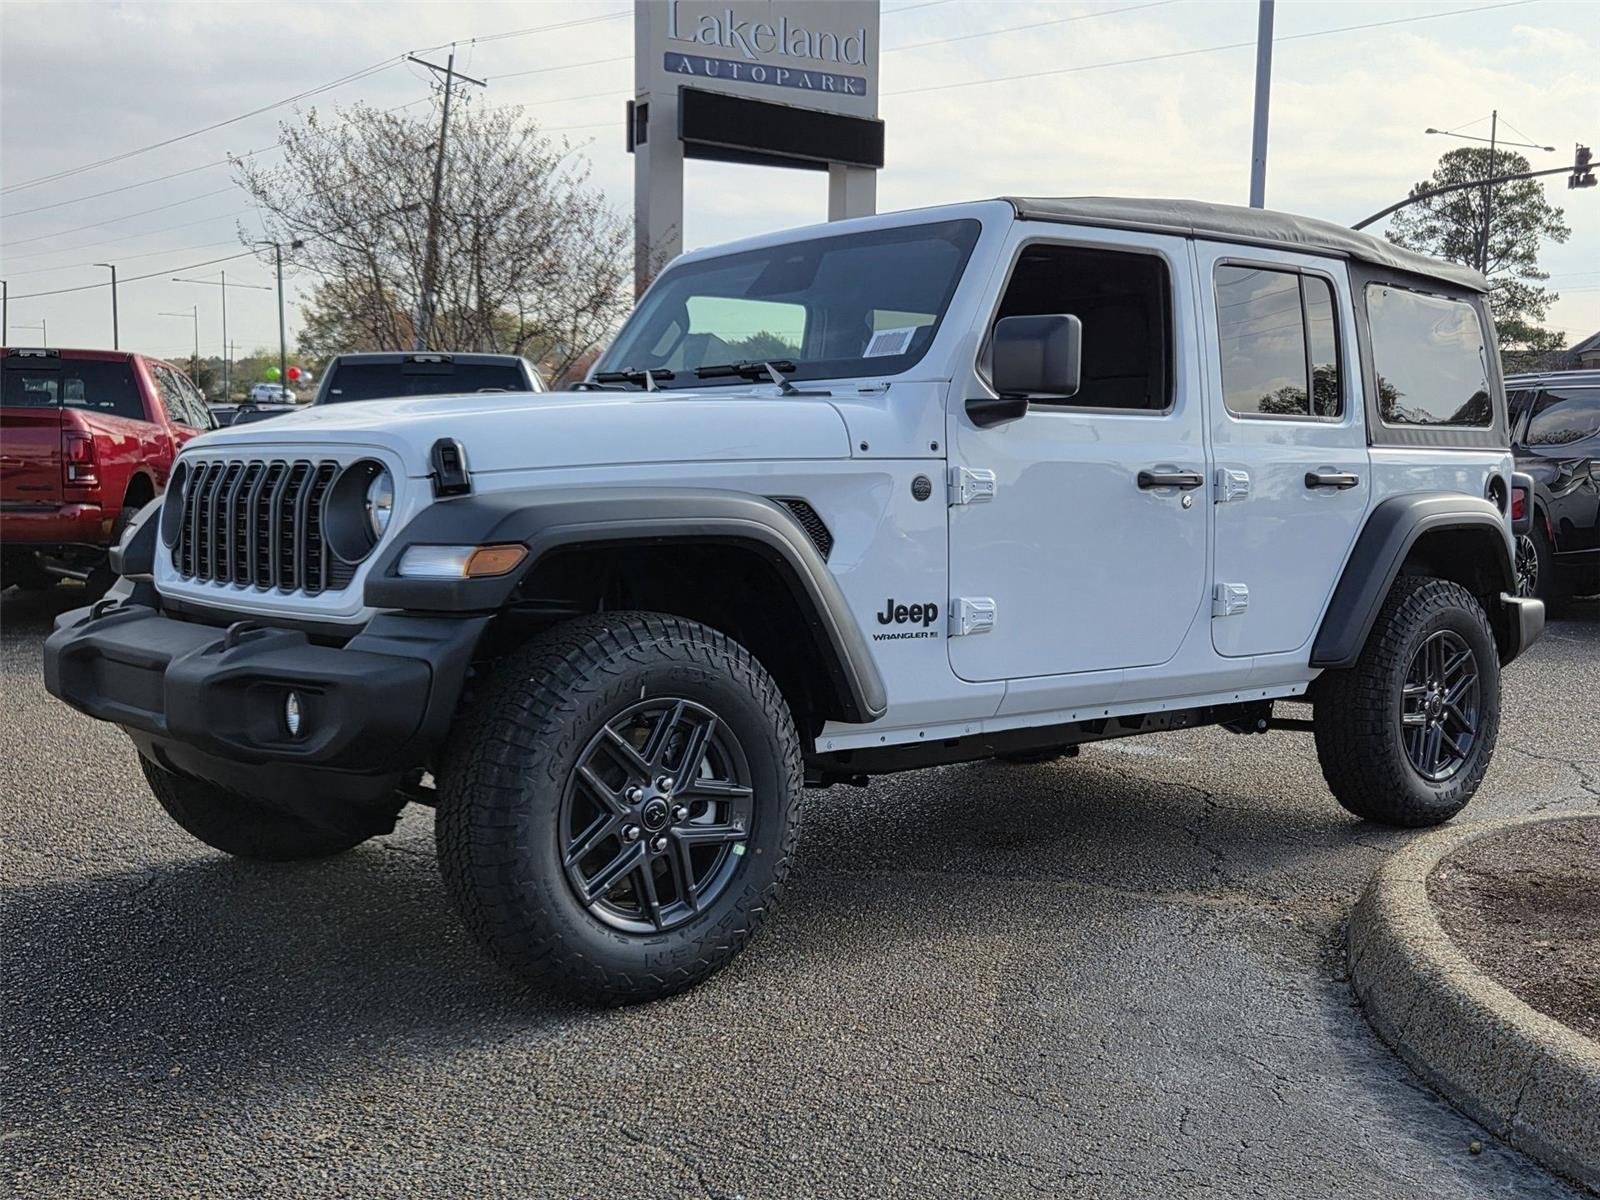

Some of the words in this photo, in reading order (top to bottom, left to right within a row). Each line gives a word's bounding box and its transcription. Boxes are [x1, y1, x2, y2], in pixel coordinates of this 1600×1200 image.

[668, 0, 867, 66] Lakeland
[678, 57, 858, 95] AUTOPARK
[877, 599, 938, 627] Jeep
[873, 632, 928, 641] WRANGLER
